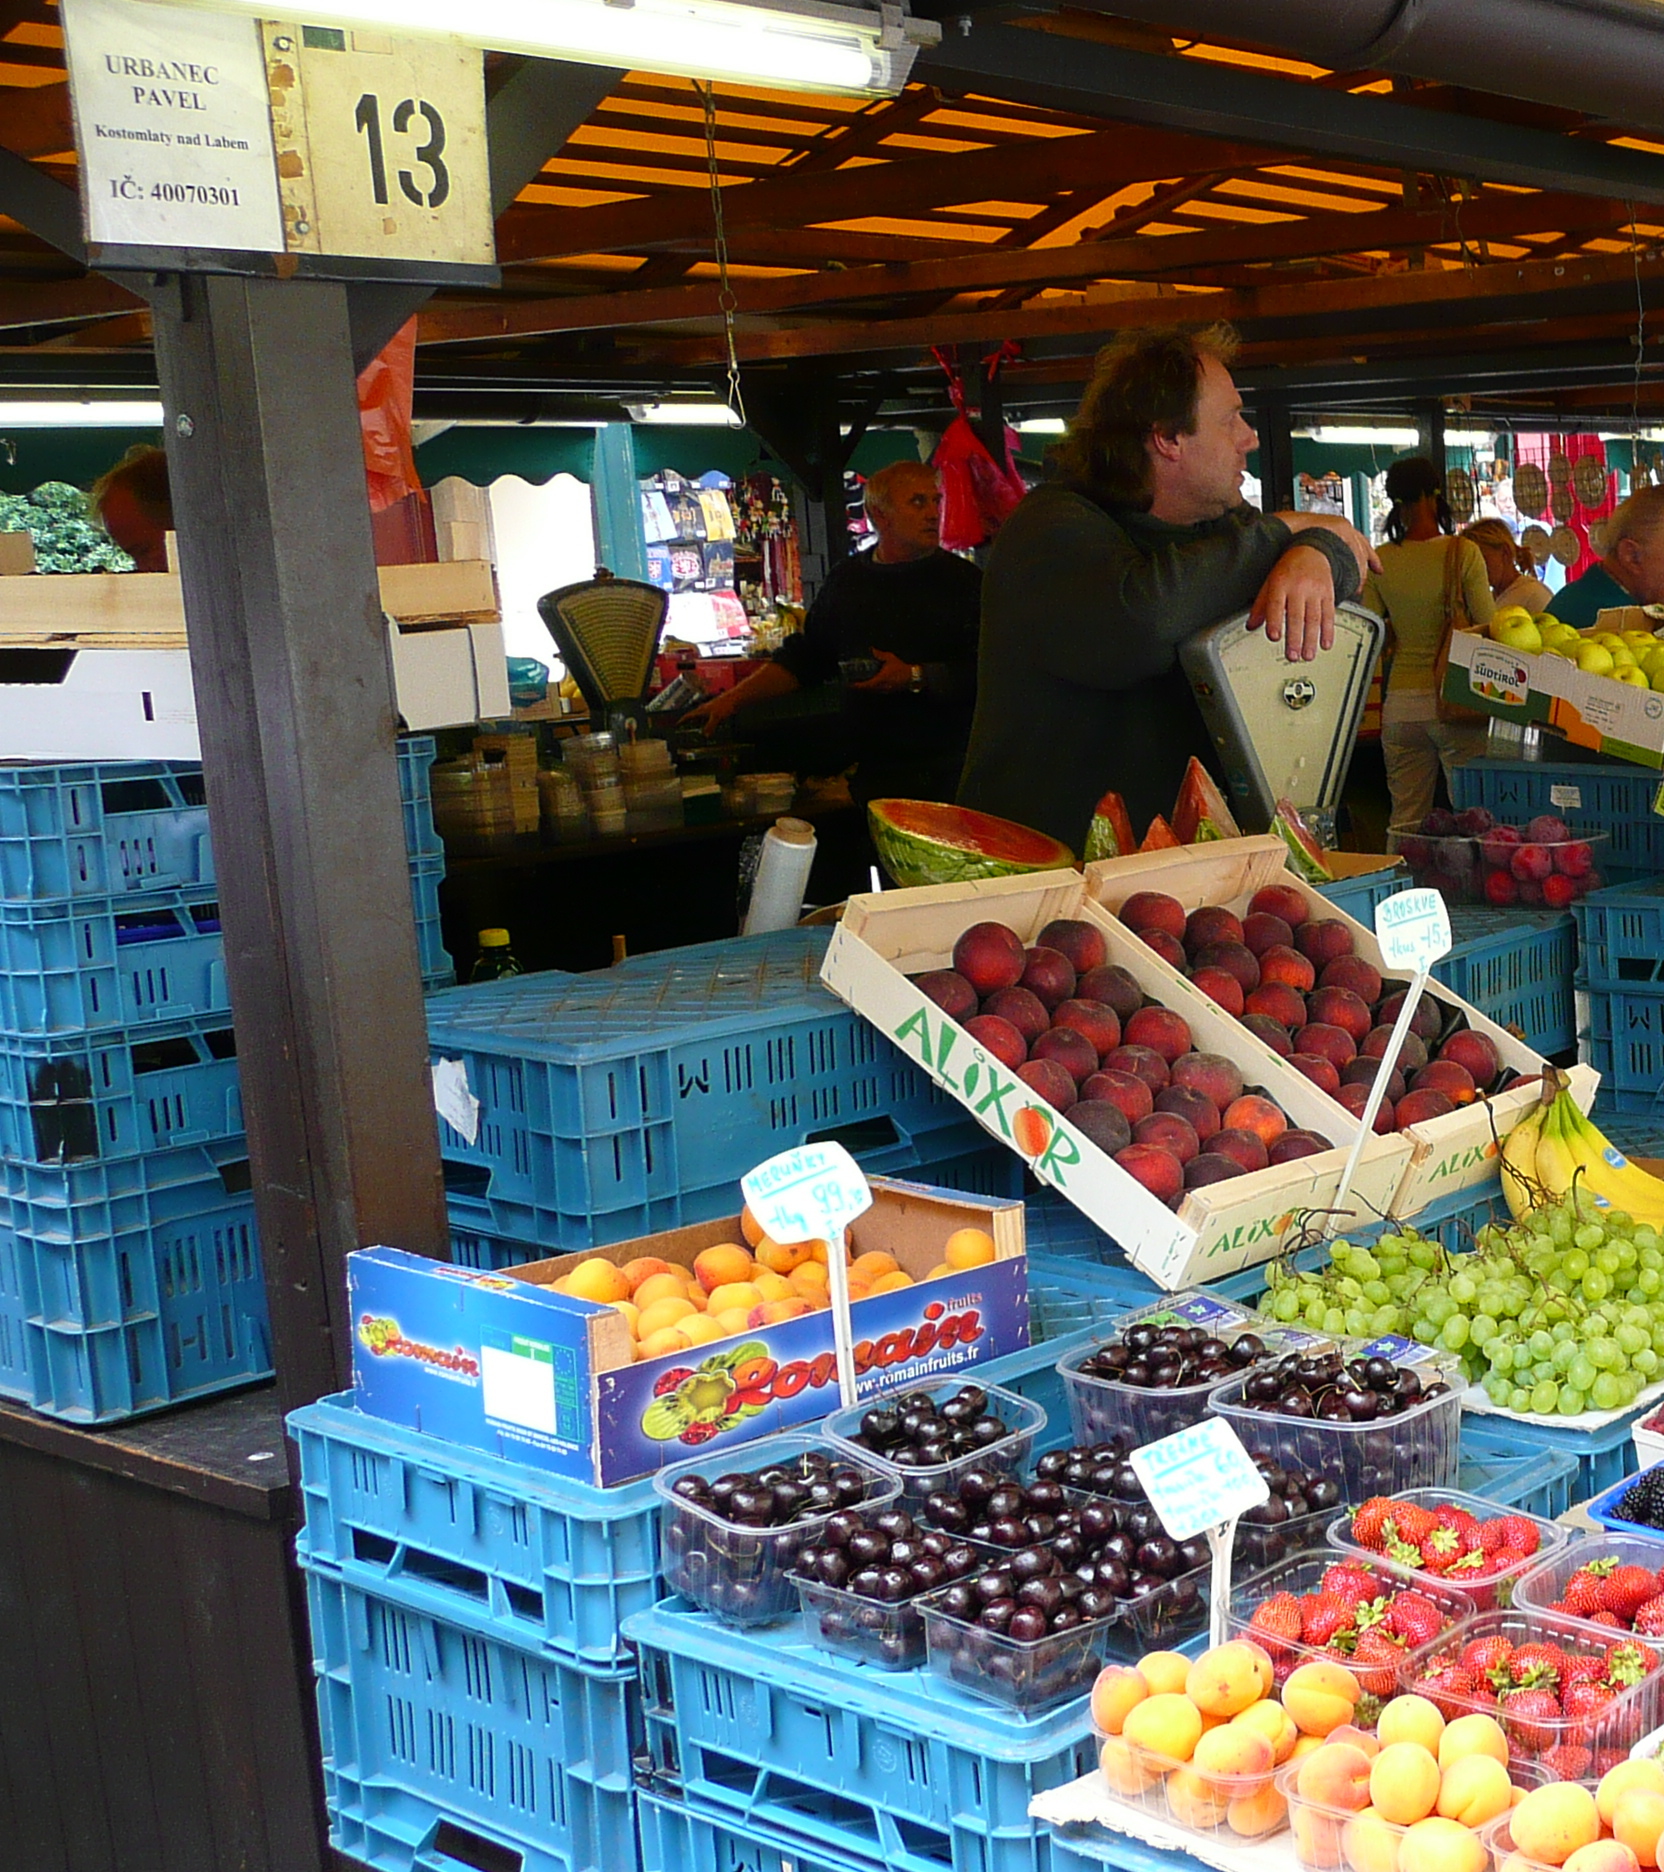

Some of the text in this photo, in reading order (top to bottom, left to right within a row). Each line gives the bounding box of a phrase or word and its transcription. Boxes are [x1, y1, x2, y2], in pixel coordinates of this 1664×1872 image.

[105, 54, 219, 85] URBANEC
[132, 86, 207, 110] PAVEL
[95, 124, 249, 150] Kostomlaty nad Labem
[355, 94, 450, 209] 13
[109, 174, 239, 206] IČ: 40070301
[1383, 894, 1436, 921] BROSKVE
[747, 1151, 825, 1192] MERUŇKY
[947, 1292, 983, 1311] fruits
[855, 1344, 979, 1394] ww.romainfruits.fr
